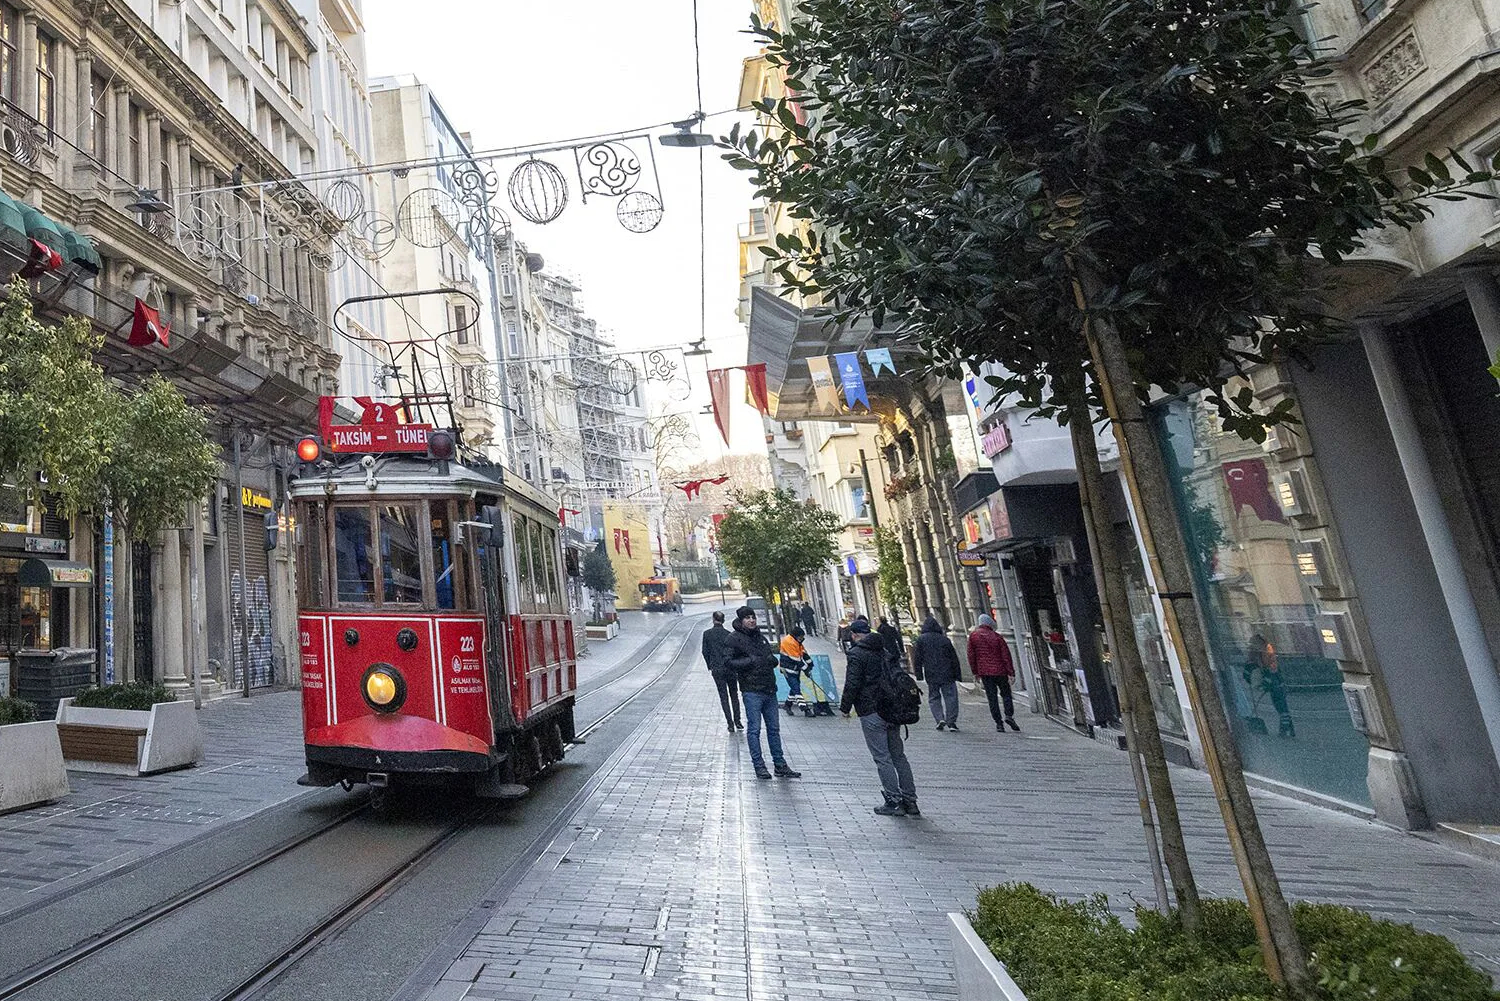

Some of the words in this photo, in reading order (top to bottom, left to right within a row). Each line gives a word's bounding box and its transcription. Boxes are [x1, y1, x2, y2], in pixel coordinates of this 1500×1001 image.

[374, 405, 384, 422] 2
[333, 428, 372, 445] TAKSİM
[461, 636, 474, 651] 223
